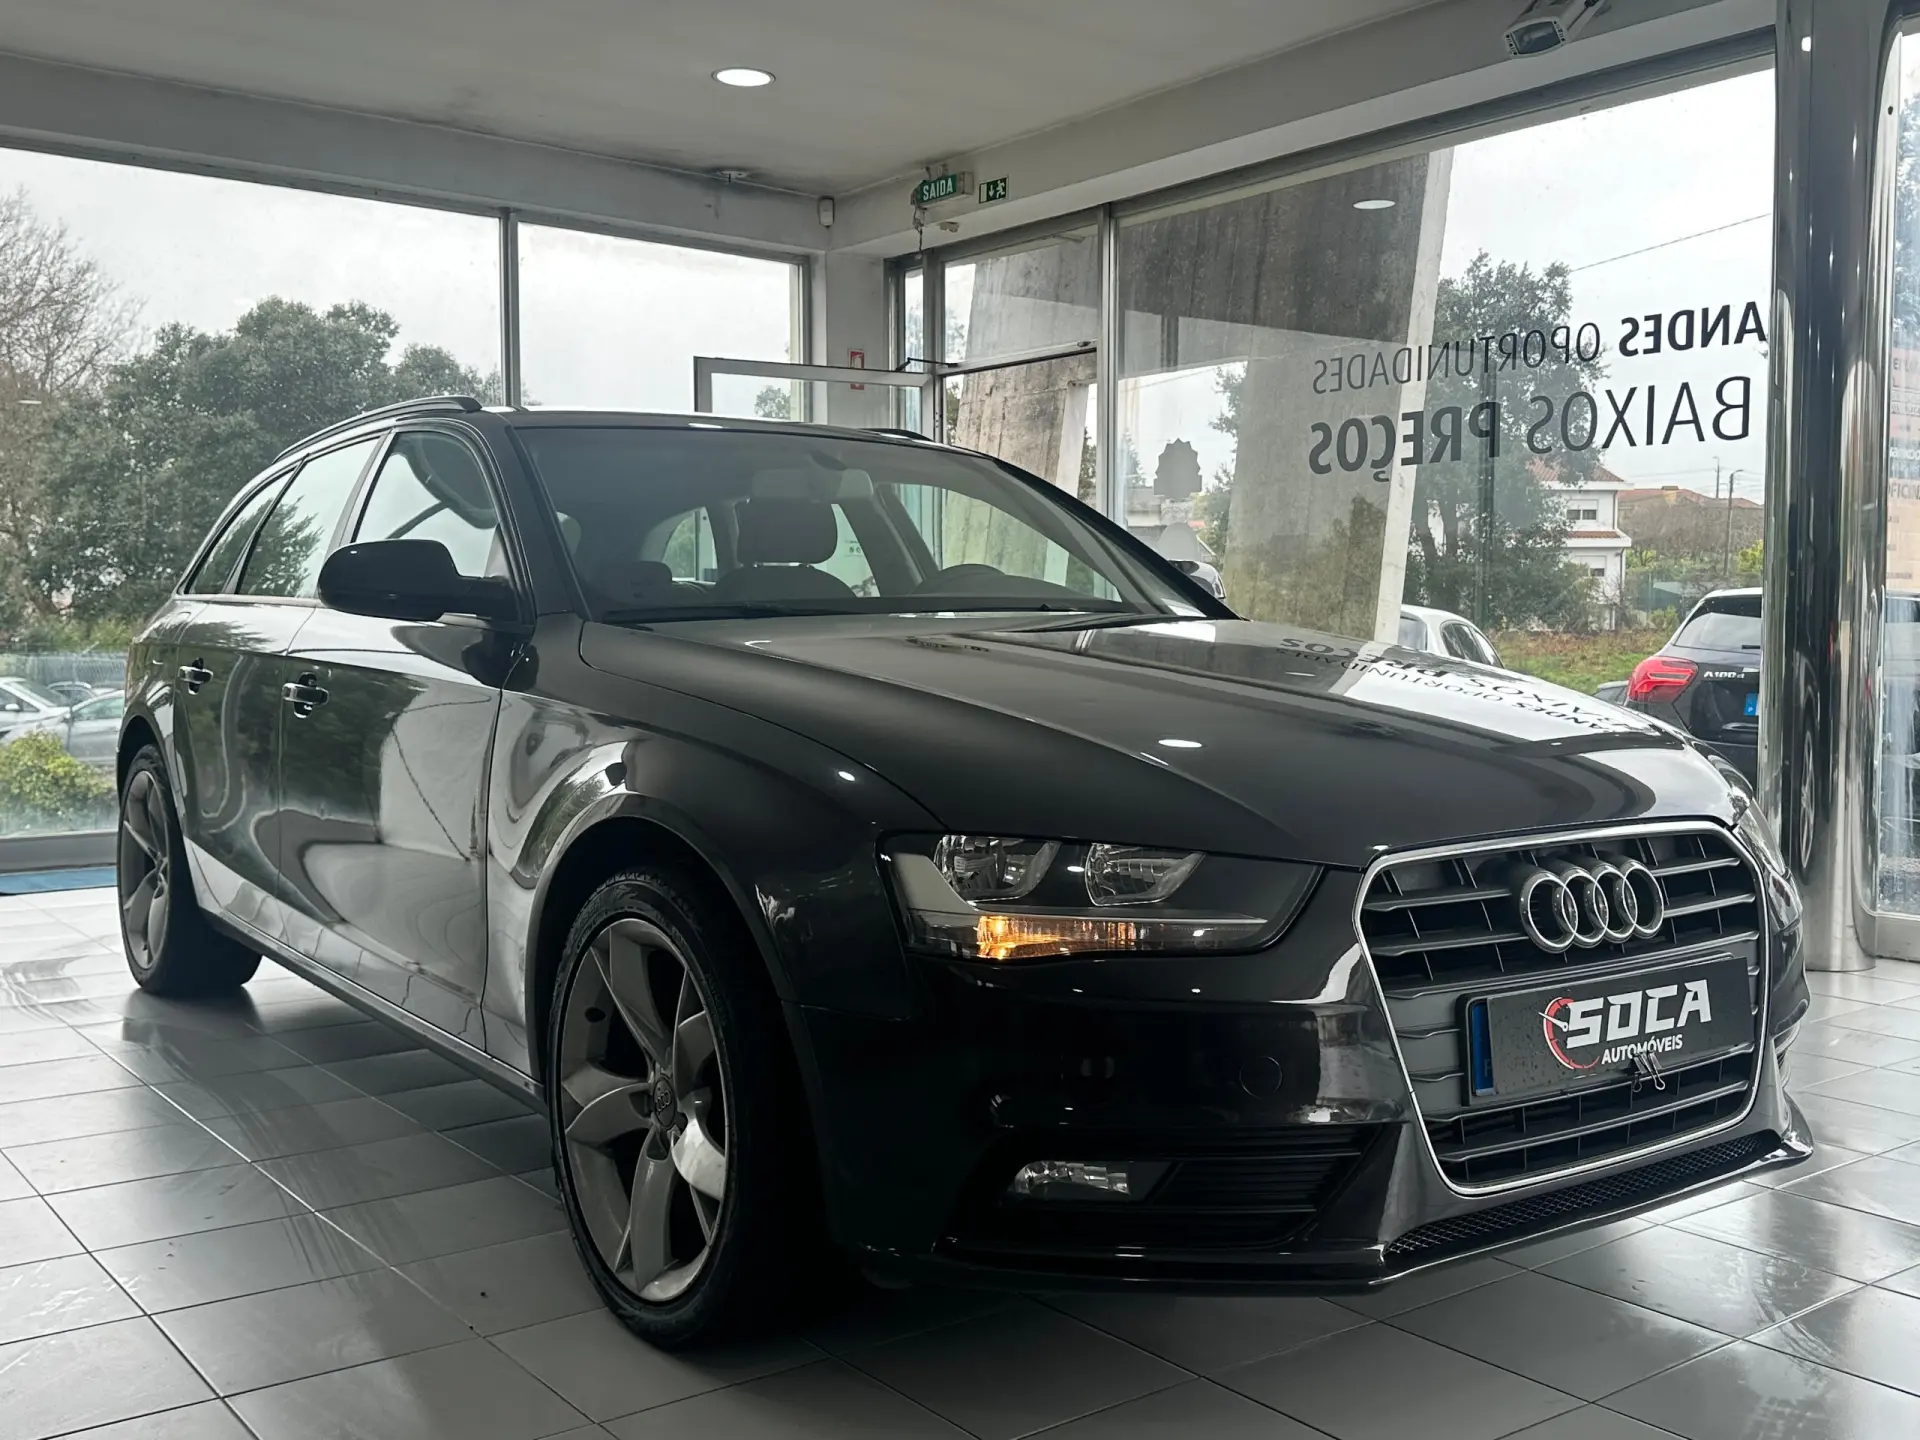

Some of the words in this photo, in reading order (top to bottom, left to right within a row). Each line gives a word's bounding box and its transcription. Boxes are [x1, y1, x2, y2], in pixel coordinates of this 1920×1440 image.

[922, 177, 954, 201] SAIDA
[1566, 979, 1712, 1049] SOCA
[1601, 1033, 1684, 1065] AUTOMÓVEIS
